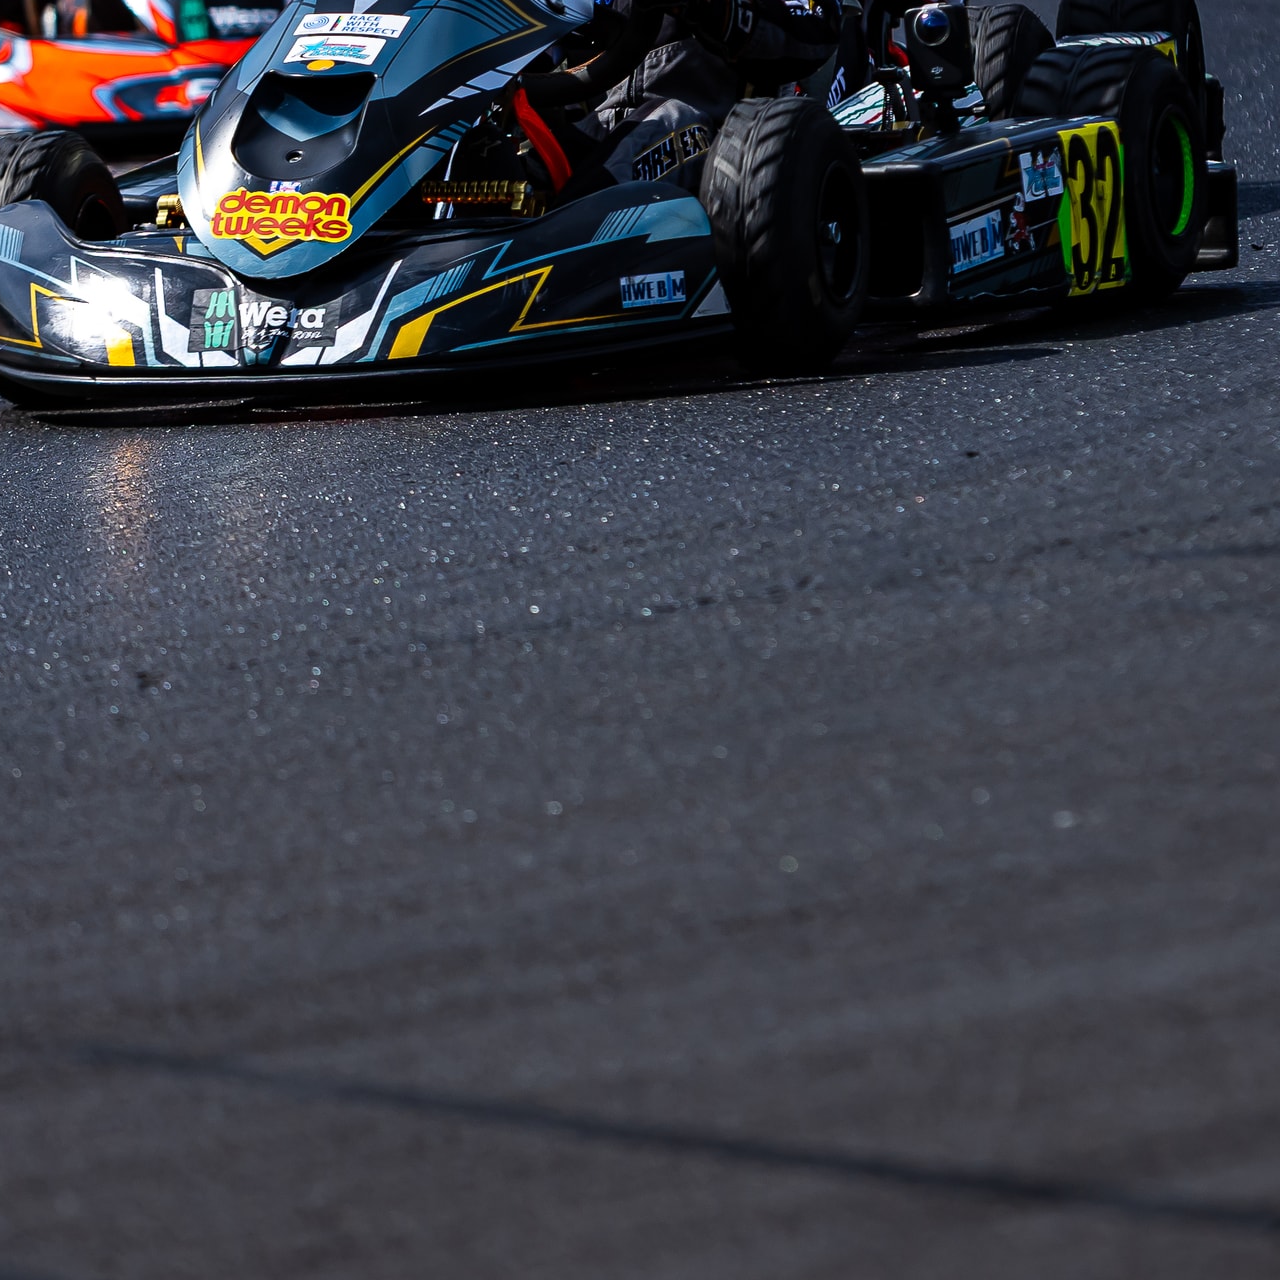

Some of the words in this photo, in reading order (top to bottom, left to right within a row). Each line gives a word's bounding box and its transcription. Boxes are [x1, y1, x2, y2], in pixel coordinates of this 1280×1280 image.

[342, 26, 398, 36] RESPECT
[220, 190, 346, 217] demon
[1068, 125, 1126, 290] 32
[212, 212, 348, 239] tweeks
[239, 301, 326, 329] Wera
[292, 330, 322, 339] REBEL
